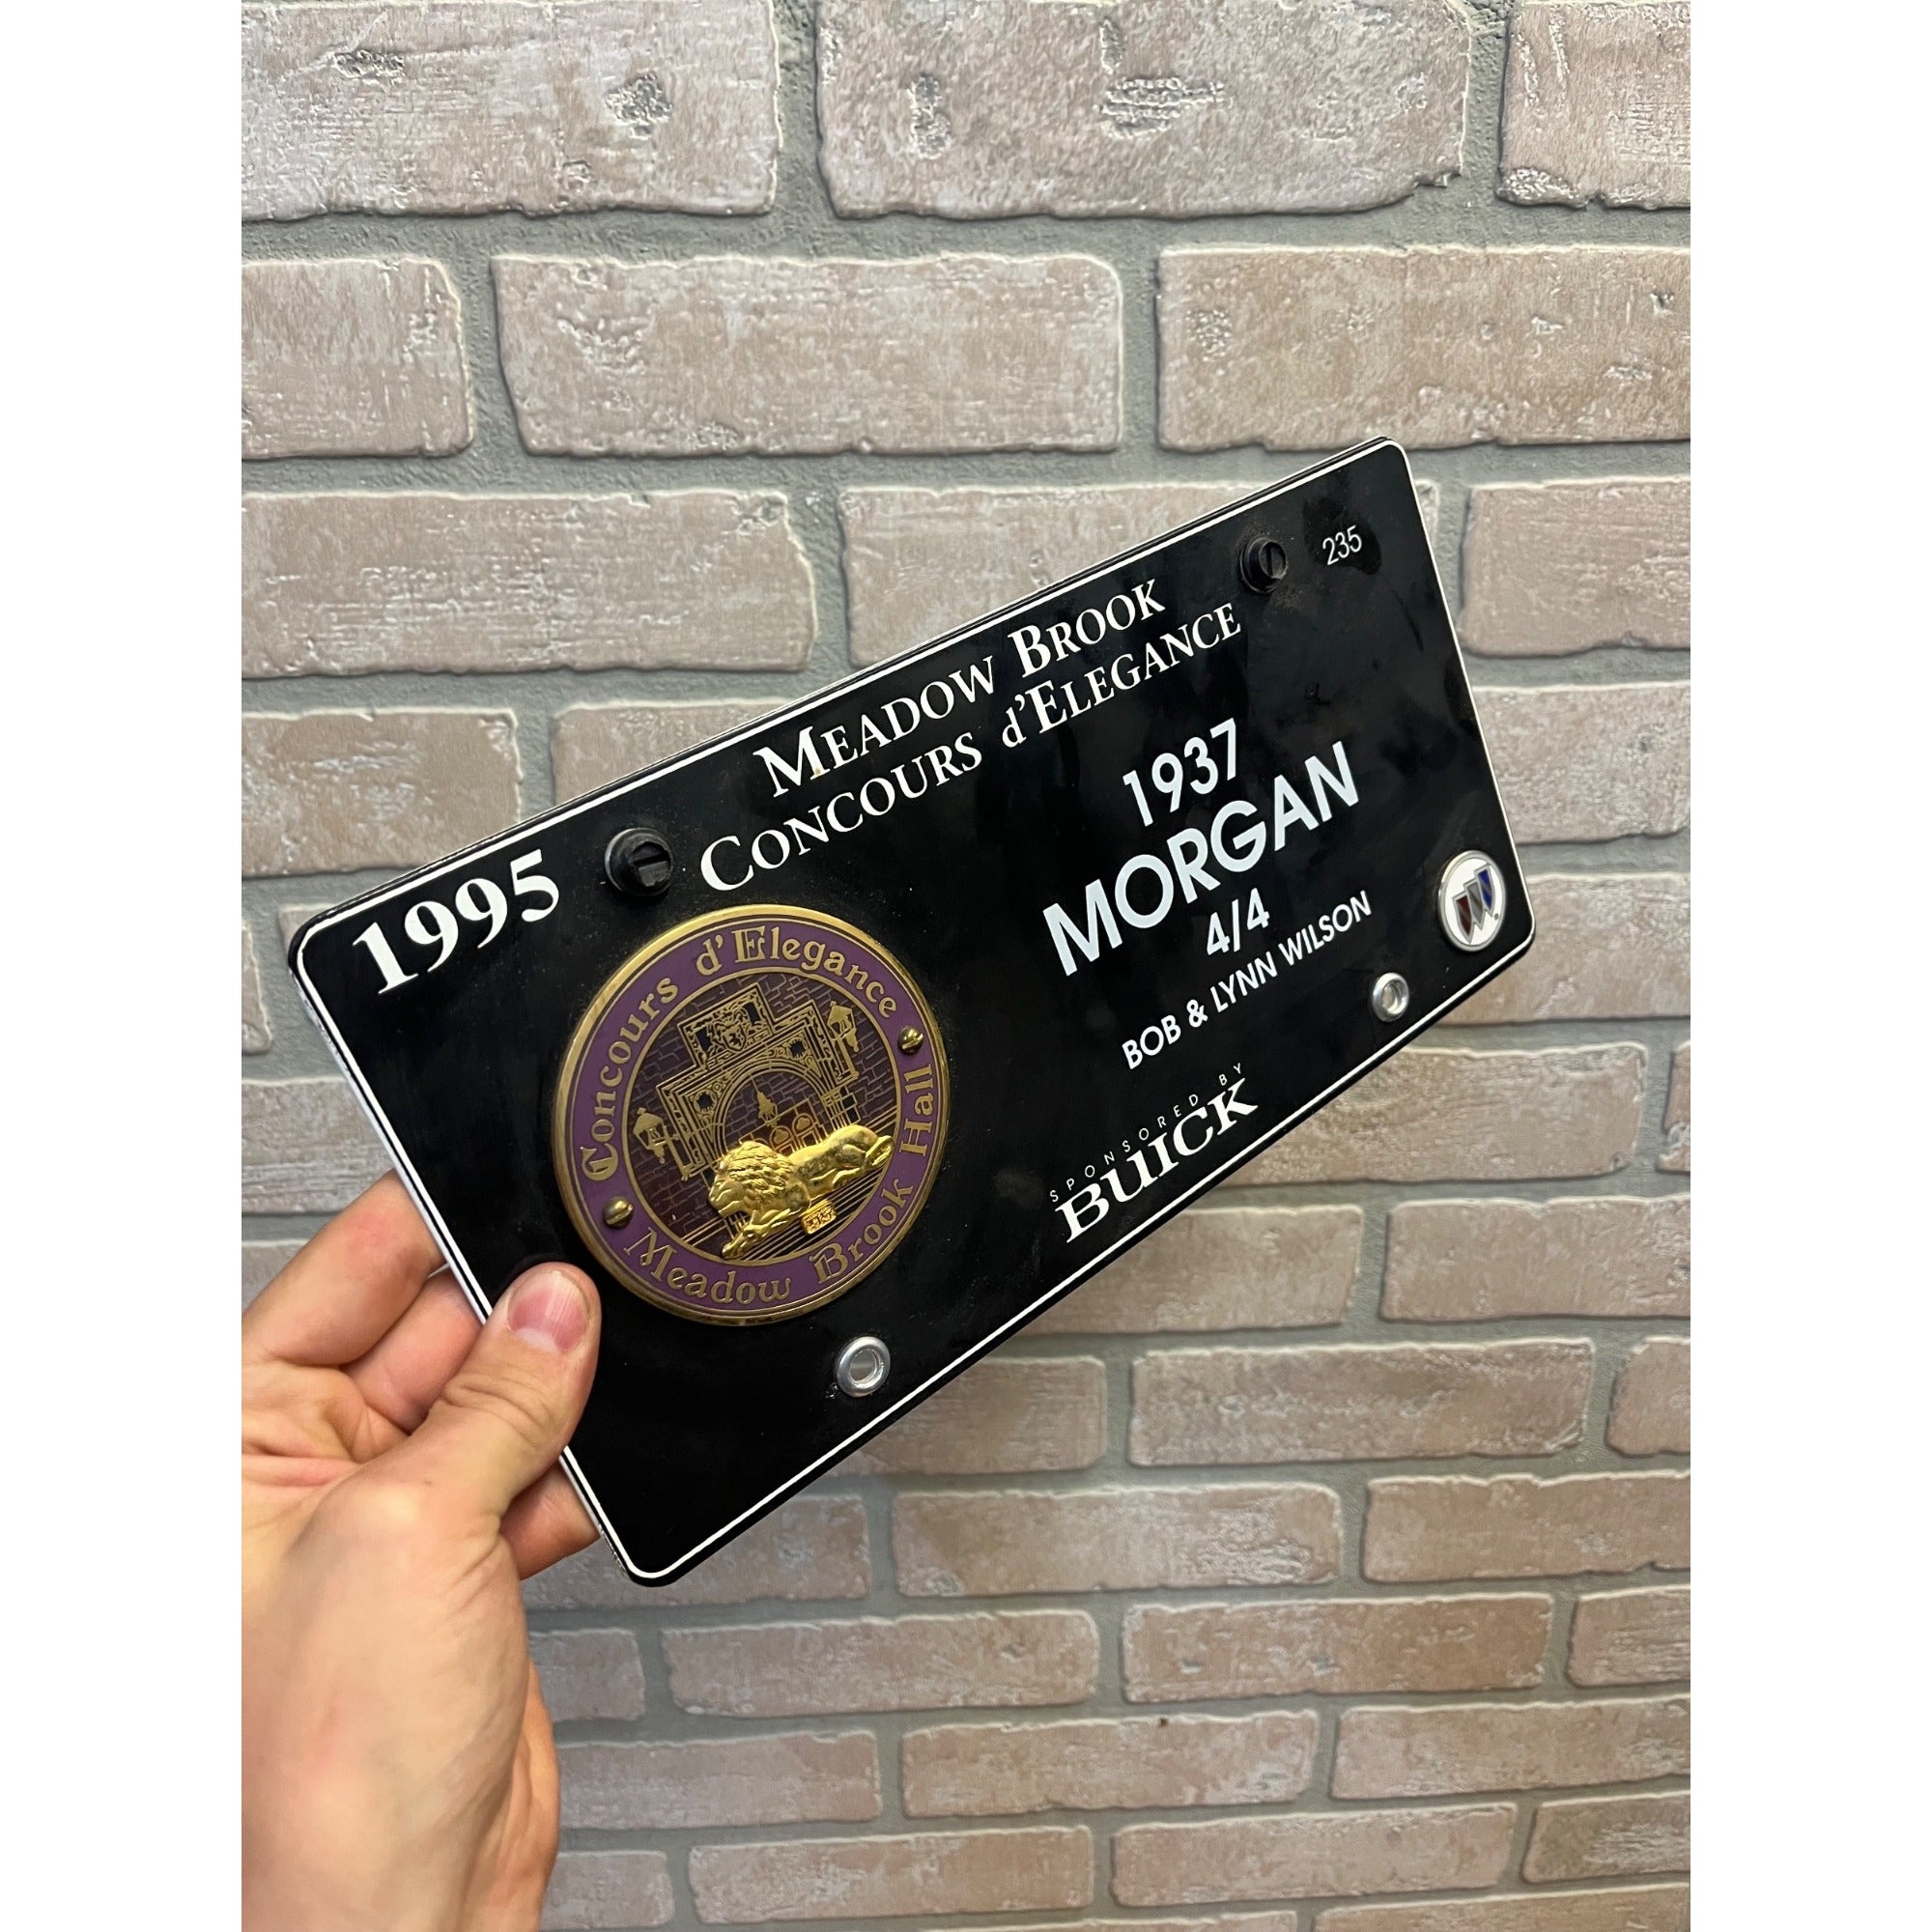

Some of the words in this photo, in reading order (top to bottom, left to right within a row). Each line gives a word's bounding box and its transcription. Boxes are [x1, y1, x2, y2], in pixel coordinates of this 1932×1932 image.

[1321, 525, 1362, 566] 235
[699, 732, 982, 892] CONCOURS
[1001, 602, 1242, 749] d'ELEGANCE
[753, 656, 995, 798] MEADOW
[1007, 579, 1166, 678] BROOK
[1122, 718, 1237, 827] 1937
[352, 849, 561, 995] 1995
[1042, 740, 1359, 977] MORGAN
[1205, 888, 1269, 956] 4/4
[582, 973, 679, 1181] Concours
[696, 925, 897, 1019] d'Elegance
[1122, 1014, 1181, 1069] BOB
[1186, 1000, 1208, 1027] &
[1209, 951, 1277, 1013] LYNN
[1277, 891, 1372, 966] WILSON
[623, 1230, 792, 1305] Meadow
[809, 1178, 914, 1286] Brook
[899, 1063, 936, 1158] Hall
[1049, 1093, 1199, 1203] SPONSORED
[1217, 1063, 1242, 1087] BY
[1055, 1077, 1258, 1243] BUICK
